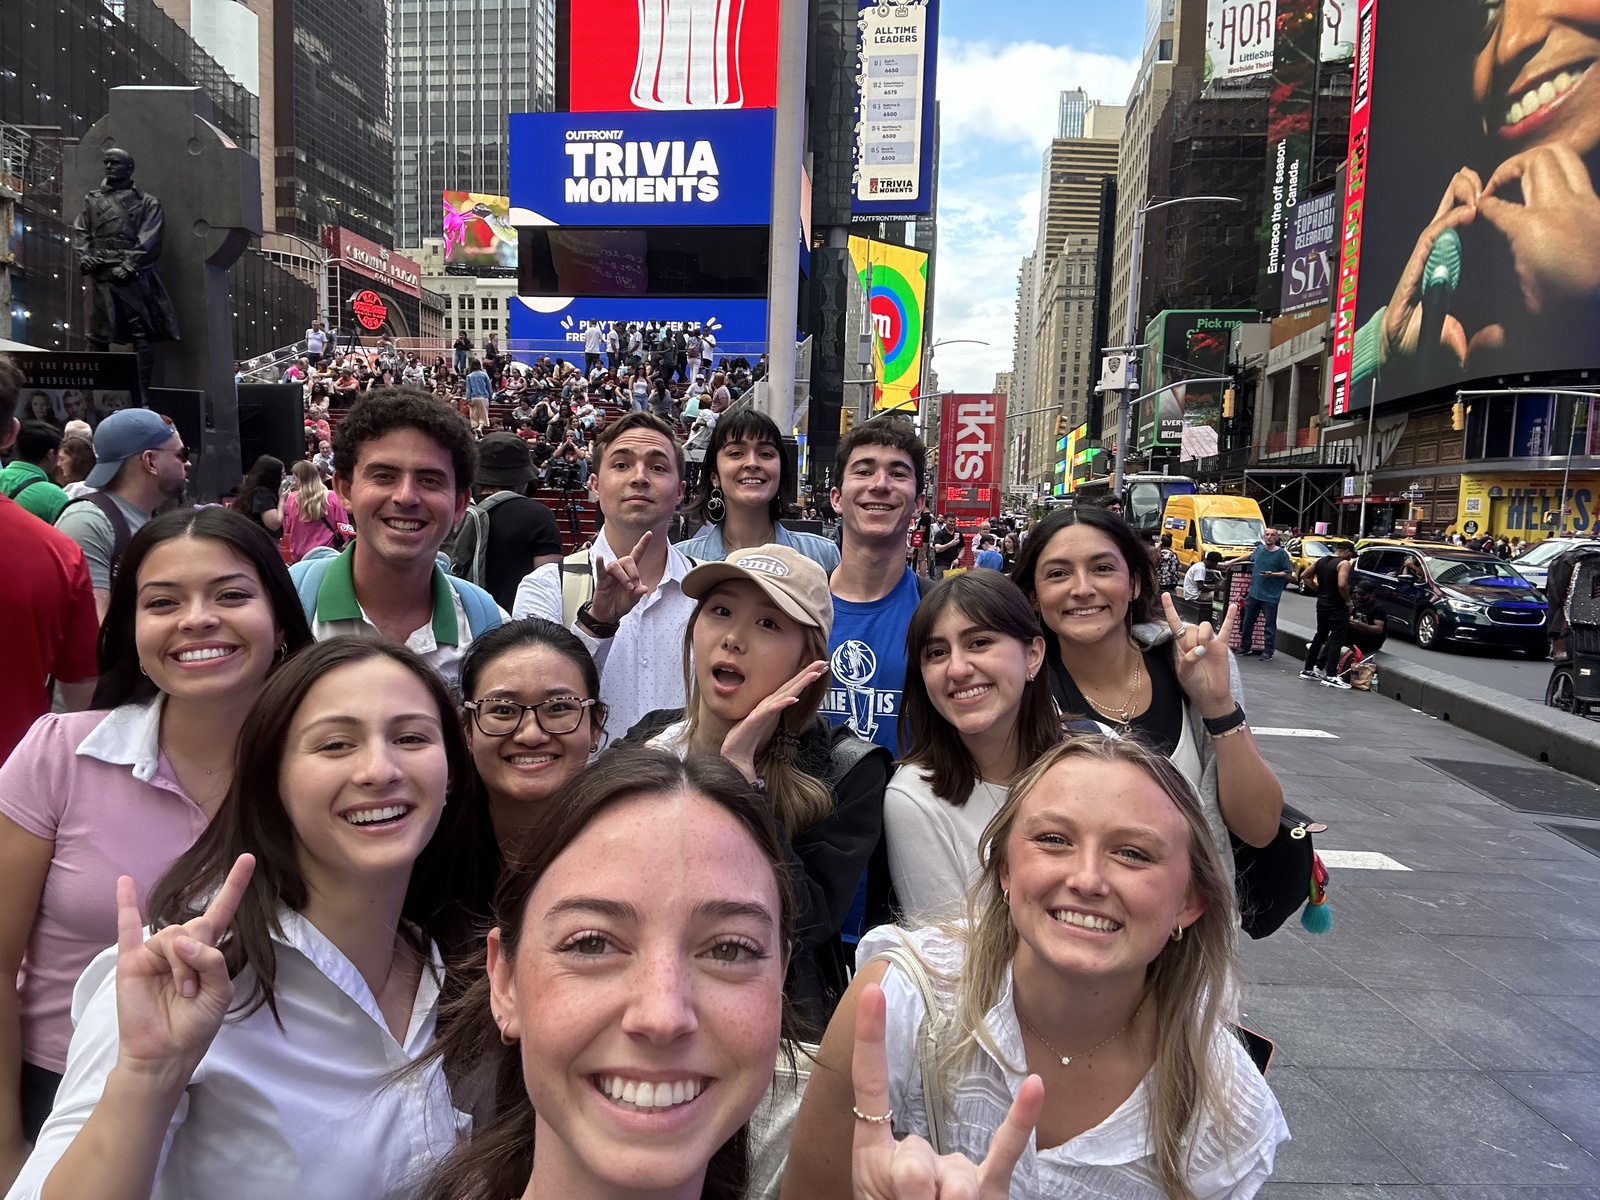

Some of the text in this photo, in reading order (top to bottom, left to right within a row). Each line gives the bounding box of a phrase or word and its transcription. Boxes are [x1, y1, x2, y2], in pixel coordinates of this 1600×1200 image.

[874, 35, 918, 43] LEADERS
[1228, 65, 1254, 74] Westside
[565, 140, 719, 177] TRIVIA
[565, 177, 719, 203] MOMENTS
[1286, 159, 1299, 207] Canada.
[1268, 138, 1286, 274] Embrace the off season.
[1298, 193, 1335, 218] BROADWAY'
[1197, 318, 1222, 328] Pick
[40, 362, 57, 370] THE
[63, 362, 100, 371] PEOPLE
[40, 377, 94, 385] REBELLION
[955, 400, 996, 480] tkts
[736, 559, 785, 576] emis
[877, 693, 894, 713] IS
